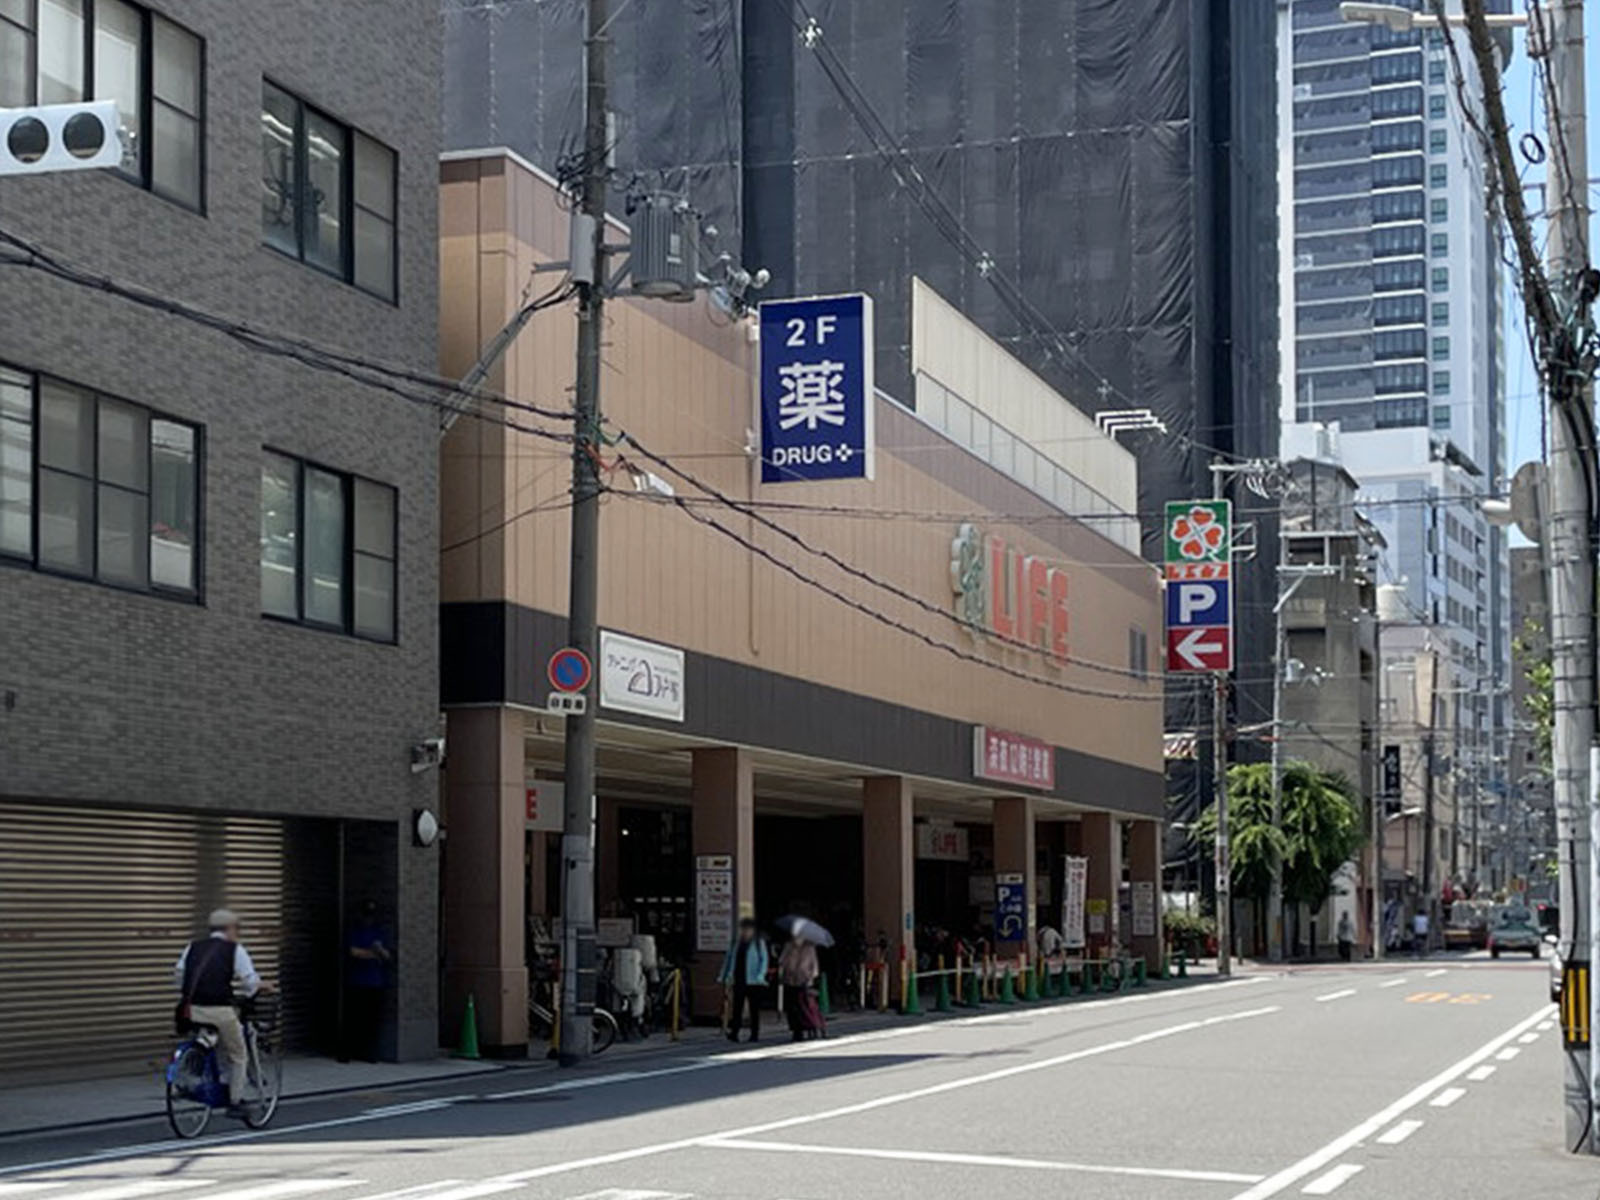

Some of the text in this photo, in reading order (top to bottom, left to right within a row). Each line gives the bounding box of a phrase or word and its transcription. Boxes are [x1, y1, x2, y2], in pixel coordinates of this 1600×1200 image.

[785, 316, 838, 346] 2F
[778, 360, 845, 430] 薬
[772, 444, 832, 466] DRUG
[990, 534, 1069, 669] LIFE
[1179, 583, 1217, 624] P
